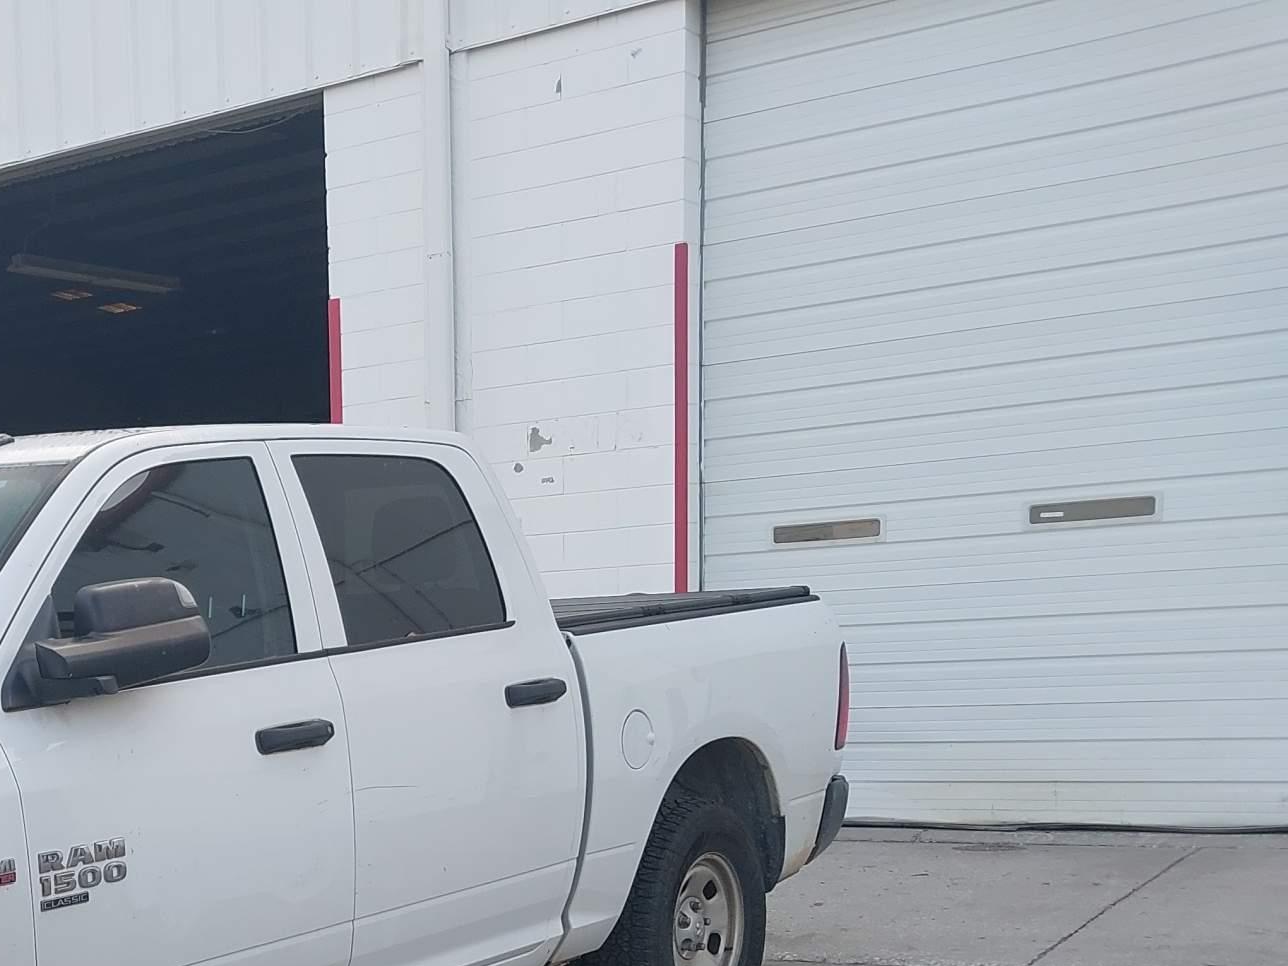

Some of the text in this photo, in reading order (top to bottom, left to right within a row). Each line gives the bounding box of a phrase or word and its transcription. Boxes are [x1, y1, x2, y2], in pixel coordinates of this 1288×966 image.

[38, 837, 126, 874] RAM
[40, 861, 127, 897] 1500
[41, 892, 89, 912] CLASSIC
